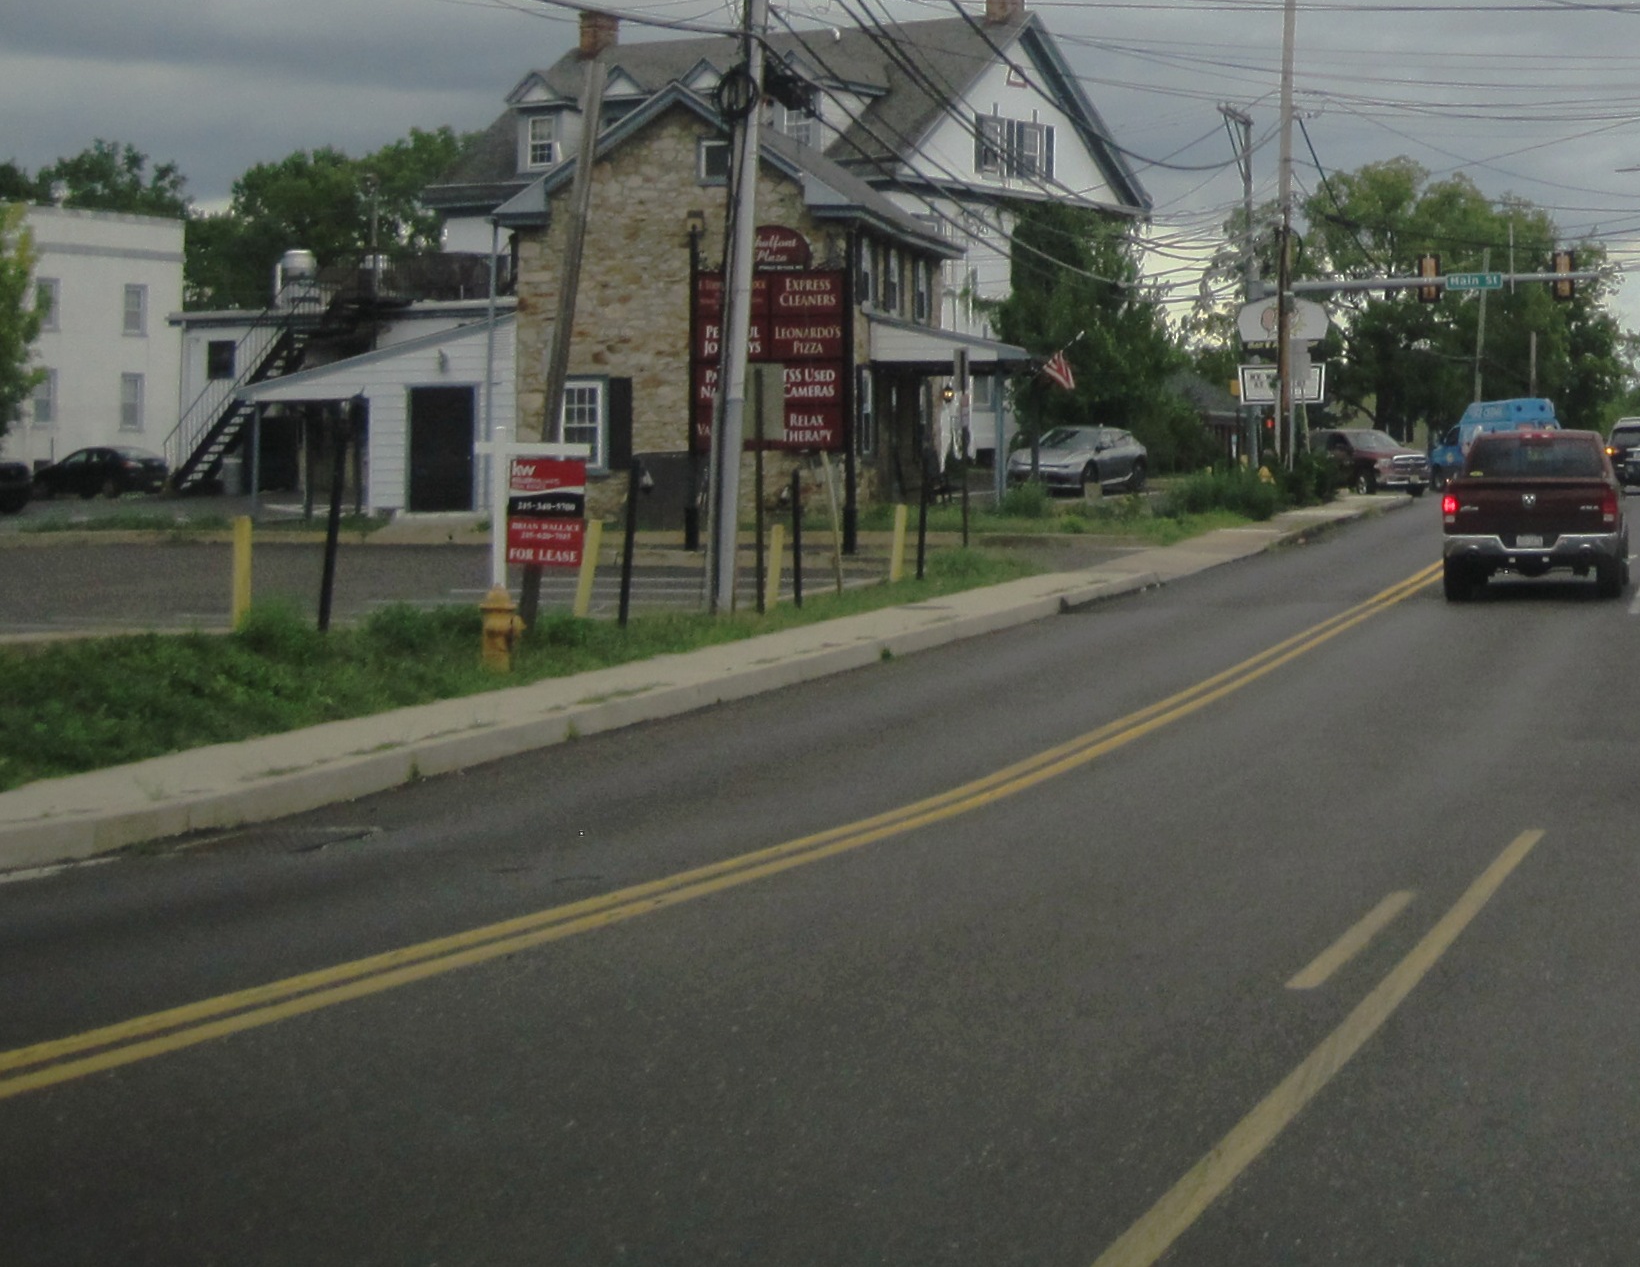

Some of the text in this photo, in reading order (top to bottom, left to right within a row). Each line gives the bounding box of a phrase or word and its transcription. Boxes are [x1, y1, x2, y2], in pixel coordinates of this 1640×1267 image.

[755, 235, 797, 250] halfont
[785, 277, 831, 292] EXPRESS
[1450, 275, 1498, 286] Main St
[779, 293, 836, 307] CLEANERS
[775, 326, 841, 340] LEONARDO'S
[793, 341, 823, 354] PIZZA
[804, 368, 835, 382] USED
[783, 385, 835, 398] CAMERAS
[790, 413, 824, 427] RELAX
[783, 429, 833, 442] THERAPY
[509, 547, 578, 563] FOR LEASE
